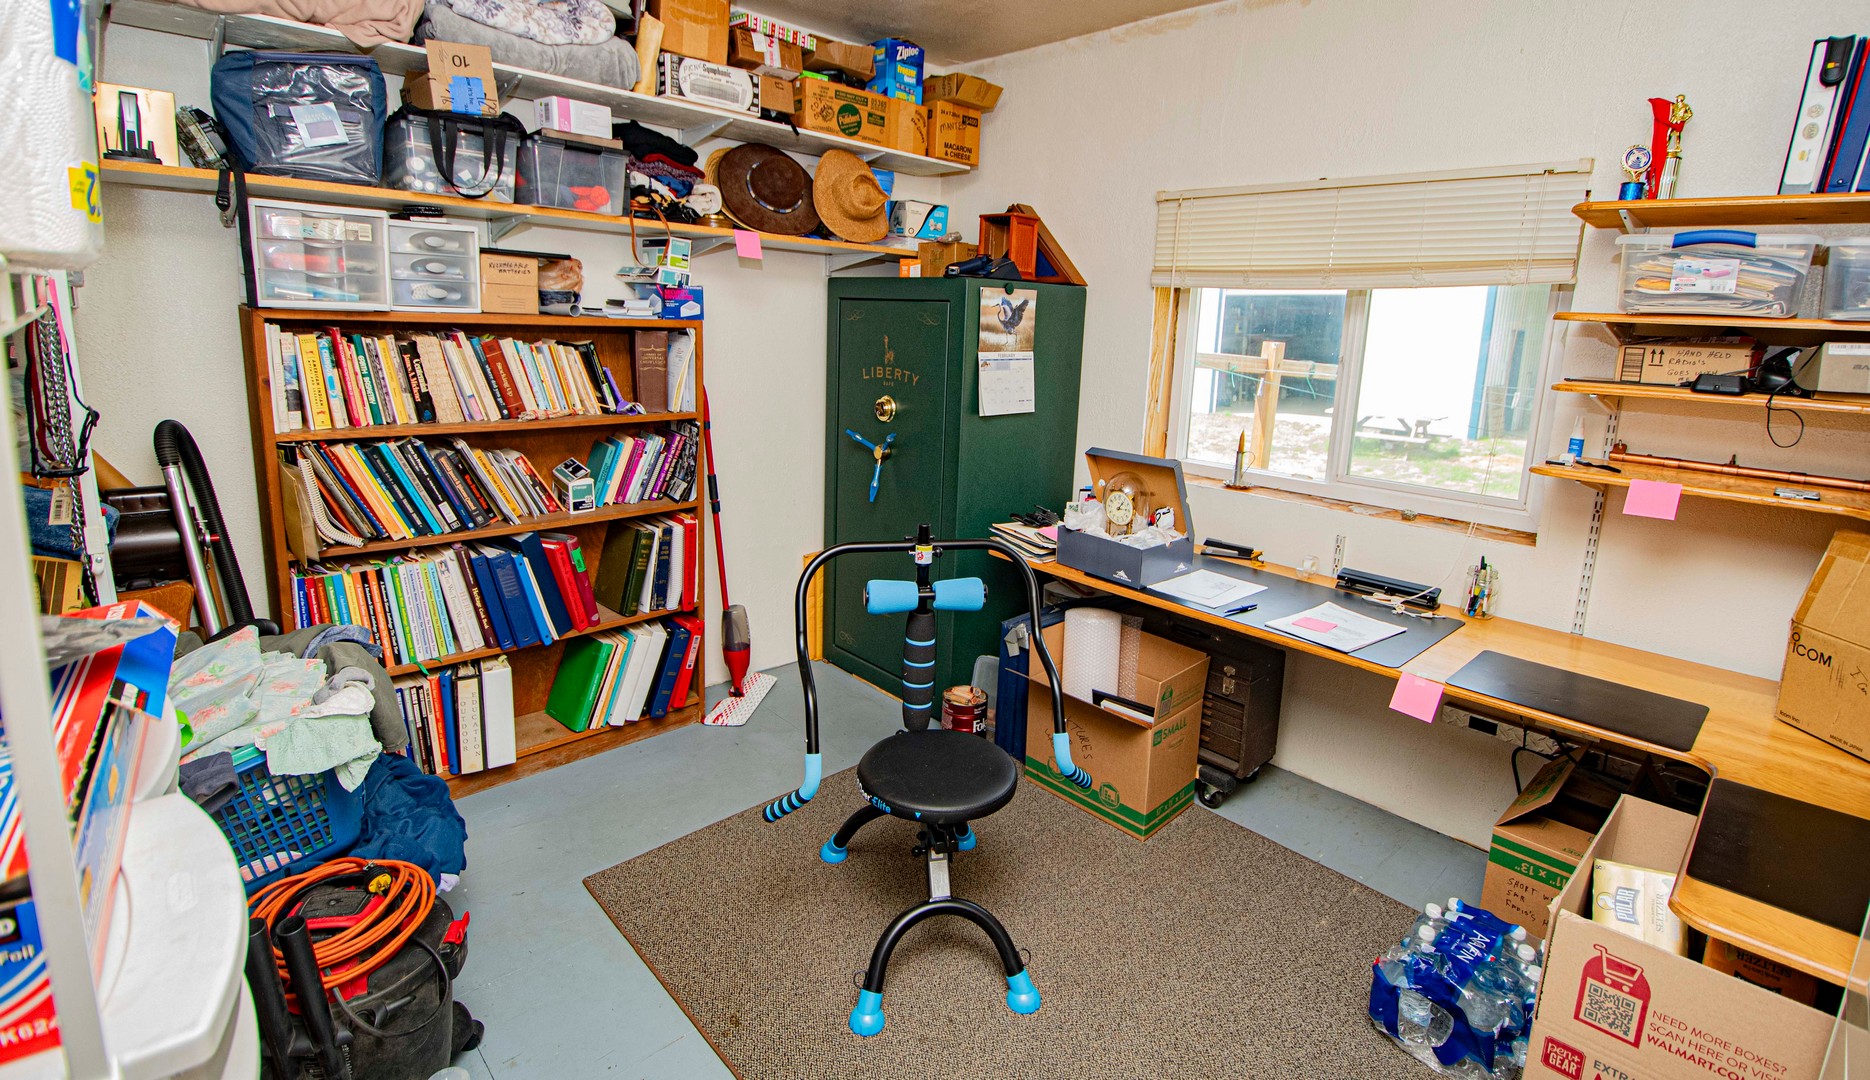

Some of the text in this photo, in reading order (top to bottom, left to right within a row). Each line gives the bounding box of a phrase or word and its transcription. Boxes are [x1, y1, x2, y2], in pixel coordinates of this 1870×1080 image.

[897, 46, 919, 61] Ziploc
[944, 142, 973, 154] MACARONI
[949, 151, 971, 161] CHEESE
[1676, 350, 1732, 360] HAND HELD
[413, 358, 428, 392] Centennial
[495, 361, 513, 397] Stocking Up
[863, 366, 919, 386] LIBERTY
[1163, 717, 1187, 740] SMALL
[1829, 733, 1843, 745] MADE
[1849, 741, 1864, 753] JAPAN
[872, 796, 891, 814] Elite
[1616, 888, 1636, 922] POLAR
[1656, 894, 1664, 933] SELTZER
[1736, 950, 1792, 978] SELTZER
[1649, 1022, 1685, 1044] SCAN
[1687, 1039, 1724, 1062] HERE
[1726, 1057, 1748, 1072] OR
[1652, 1010, 1788, 1075] NEED MORE BOXES?
[1549, 1052, 1577, 1076] GEAR
